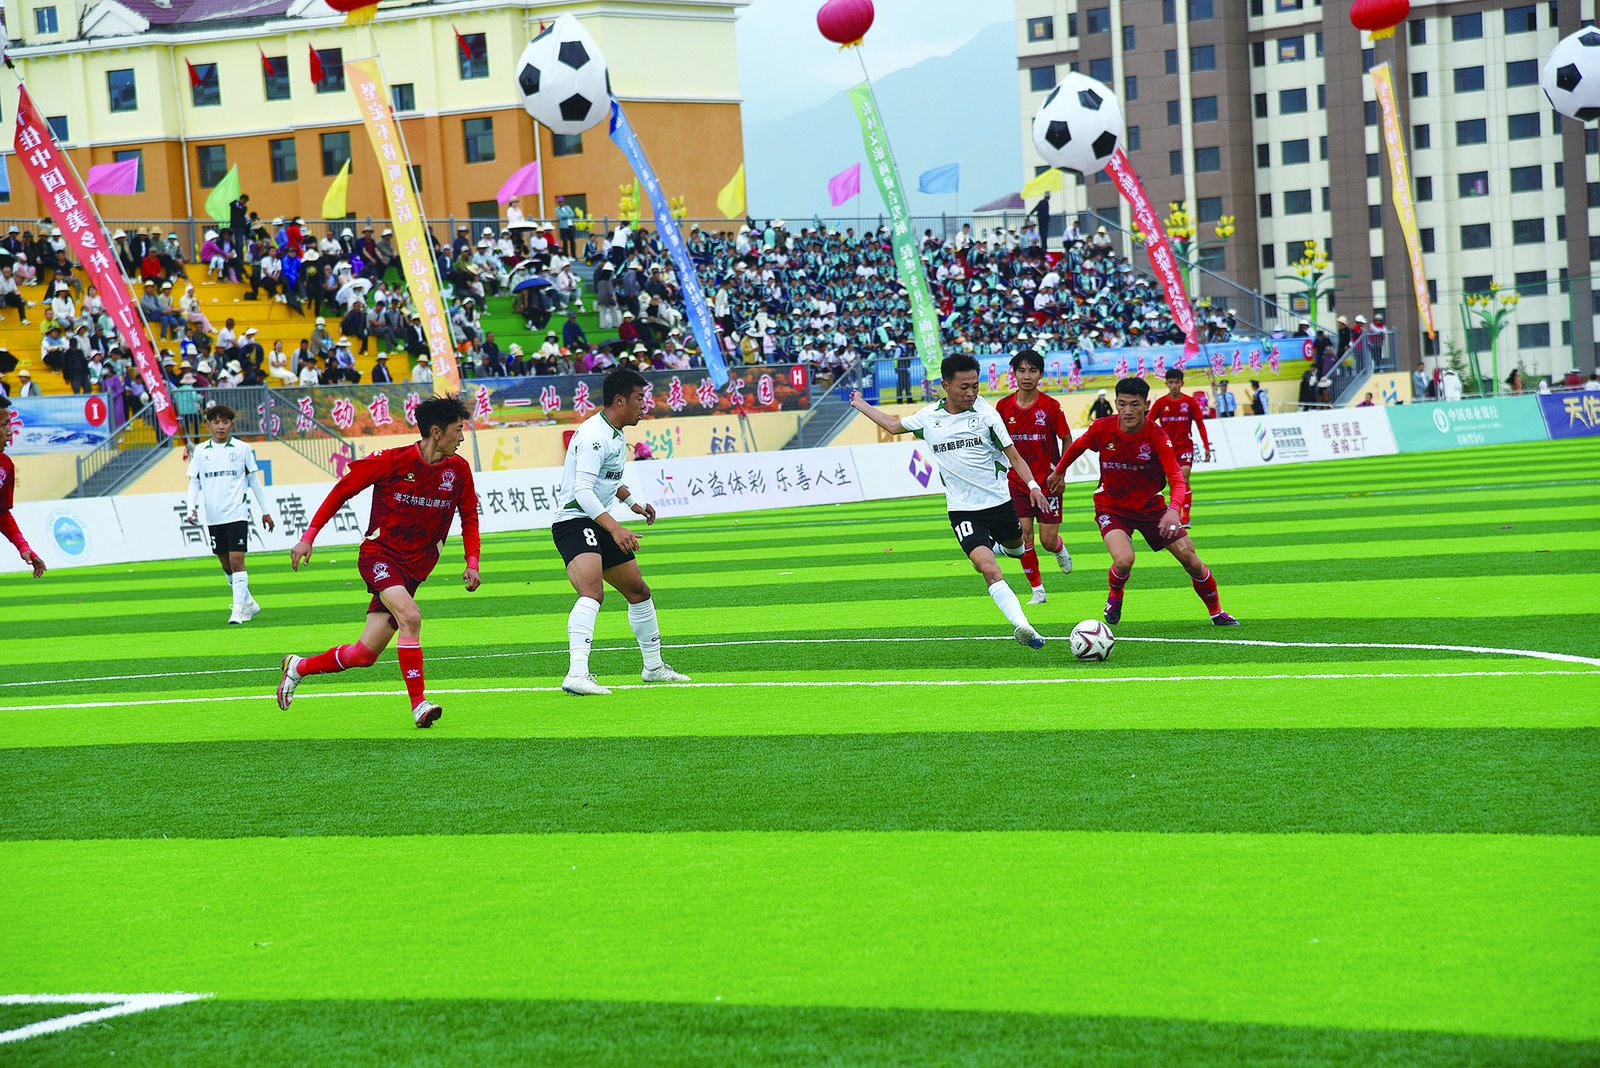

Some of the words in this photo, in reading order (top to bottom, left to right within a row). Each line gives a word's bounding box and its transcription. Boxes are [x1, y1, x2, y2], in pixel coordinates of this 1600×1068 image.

[793, 369, 803, 385] H
[688, 470, 767, 498] 公益体彩
[776, 462, 852, 492] 乐善人生
[583, 527, 598, 547] 8
[955, 520, 974, 543] 10
